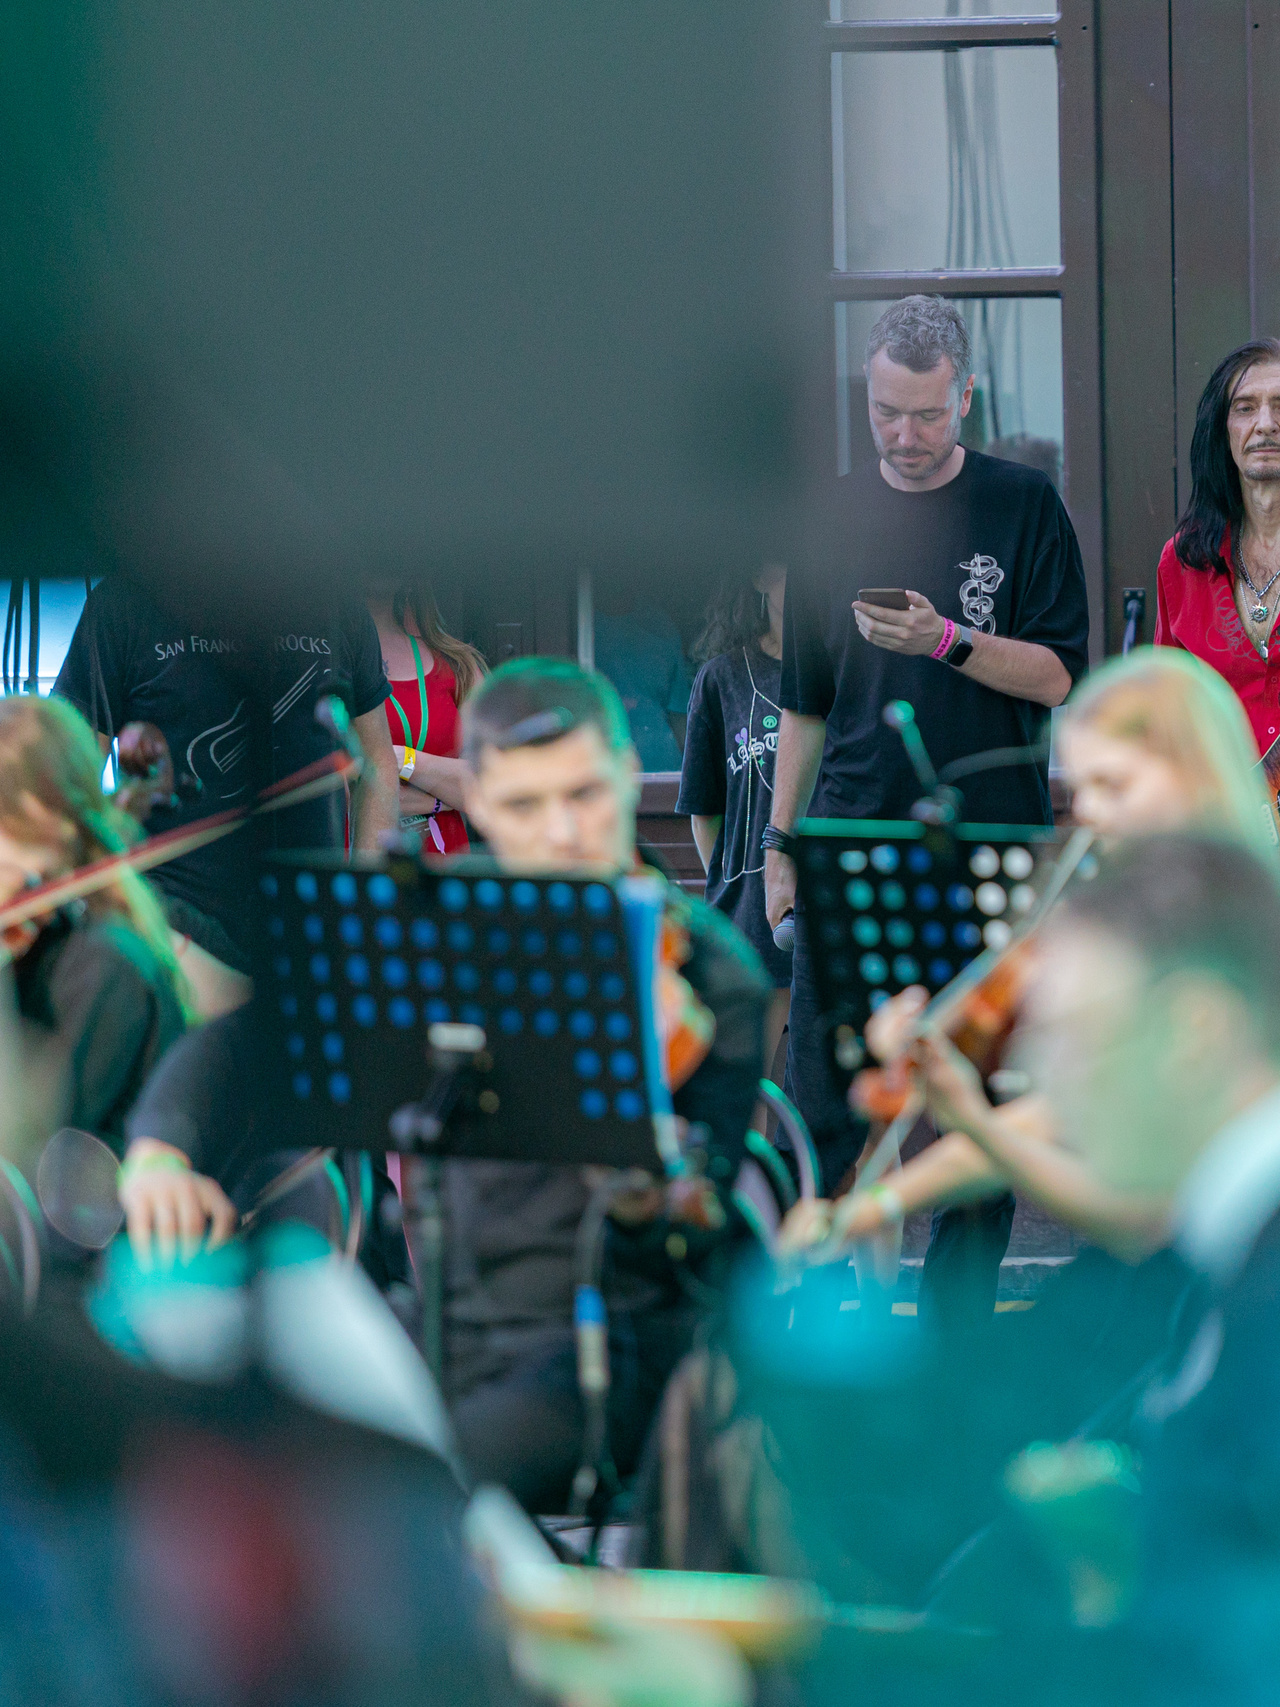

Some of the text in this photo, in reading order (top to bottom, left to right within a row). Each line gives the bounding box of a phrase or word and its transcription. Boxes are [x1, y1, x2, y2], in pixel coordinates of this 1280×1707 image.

[154, 633, 332, 661] SAN FRANC ROCKS
